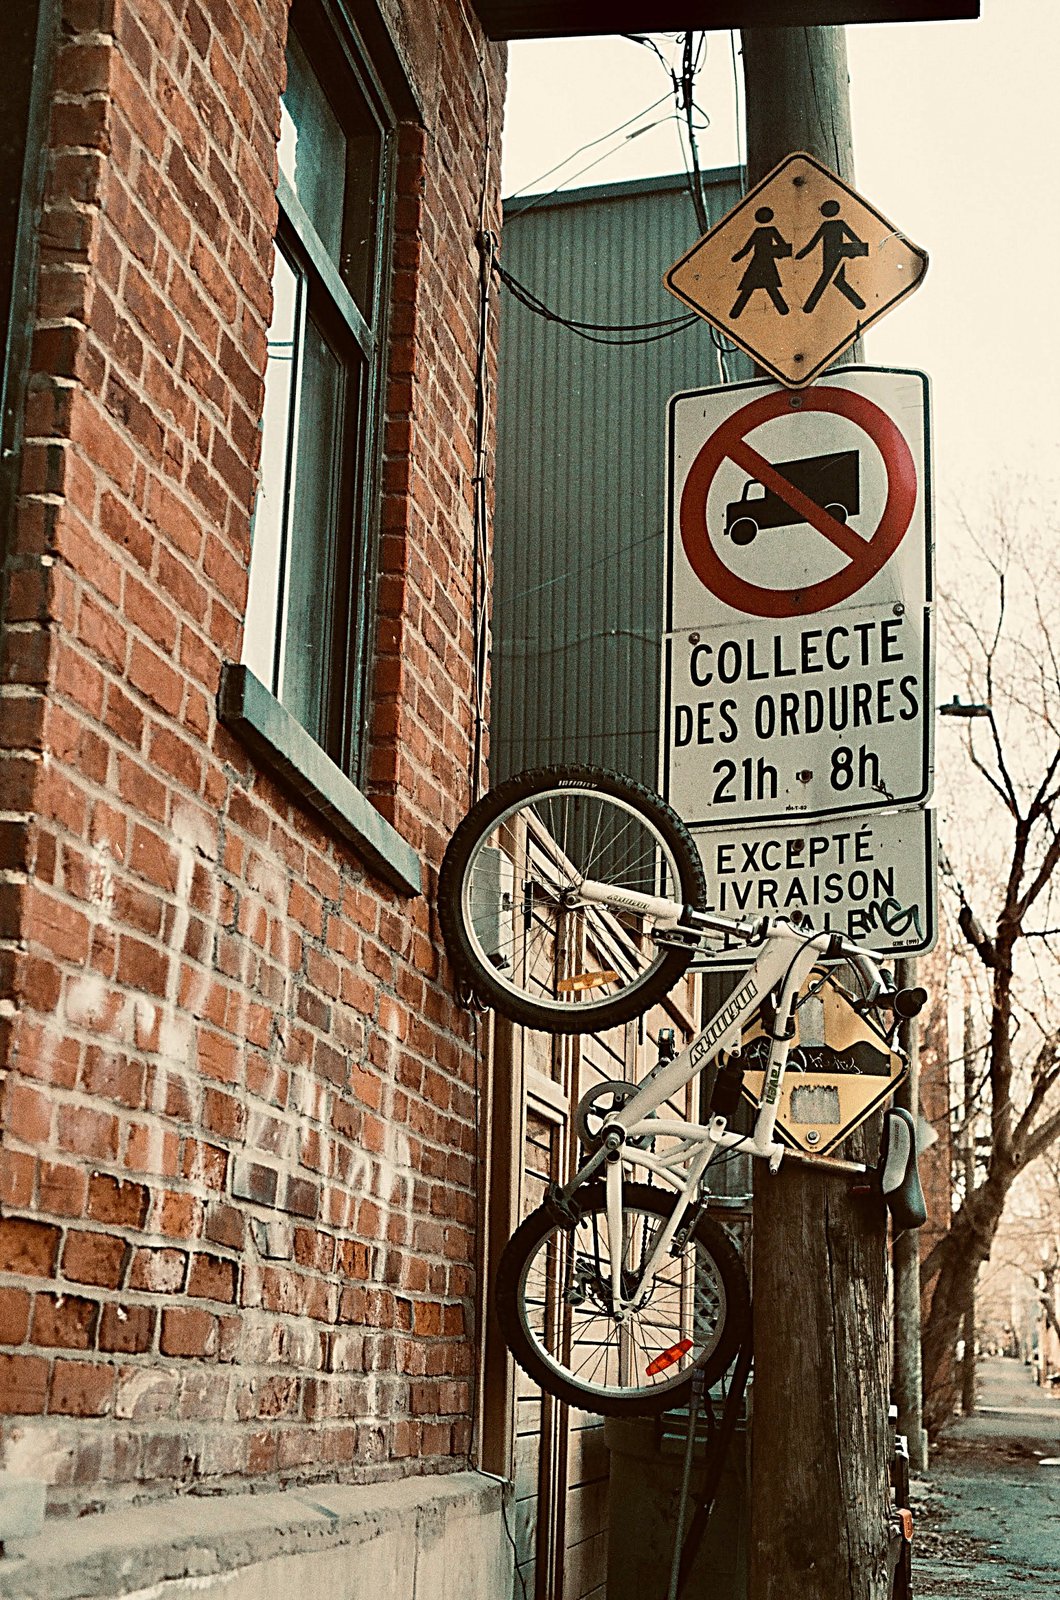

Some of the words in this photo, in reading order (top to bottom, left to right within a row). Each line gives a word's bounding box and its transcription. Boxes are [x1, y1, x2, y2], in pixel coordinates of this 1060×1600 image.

[690, 618, 904, 687] COLLECTE
[674, 699, 738, 748] DES
[755, 675, 919, 740] ORDURES
[712, 757, 778, 804] 21h
[830, 745, 879, 791] 8h
[717, 824, 874, 875] EXCEPTÉ
[705, 867, 894, 912] IVRAISON
[765, 1061, 782, 1104] raven
